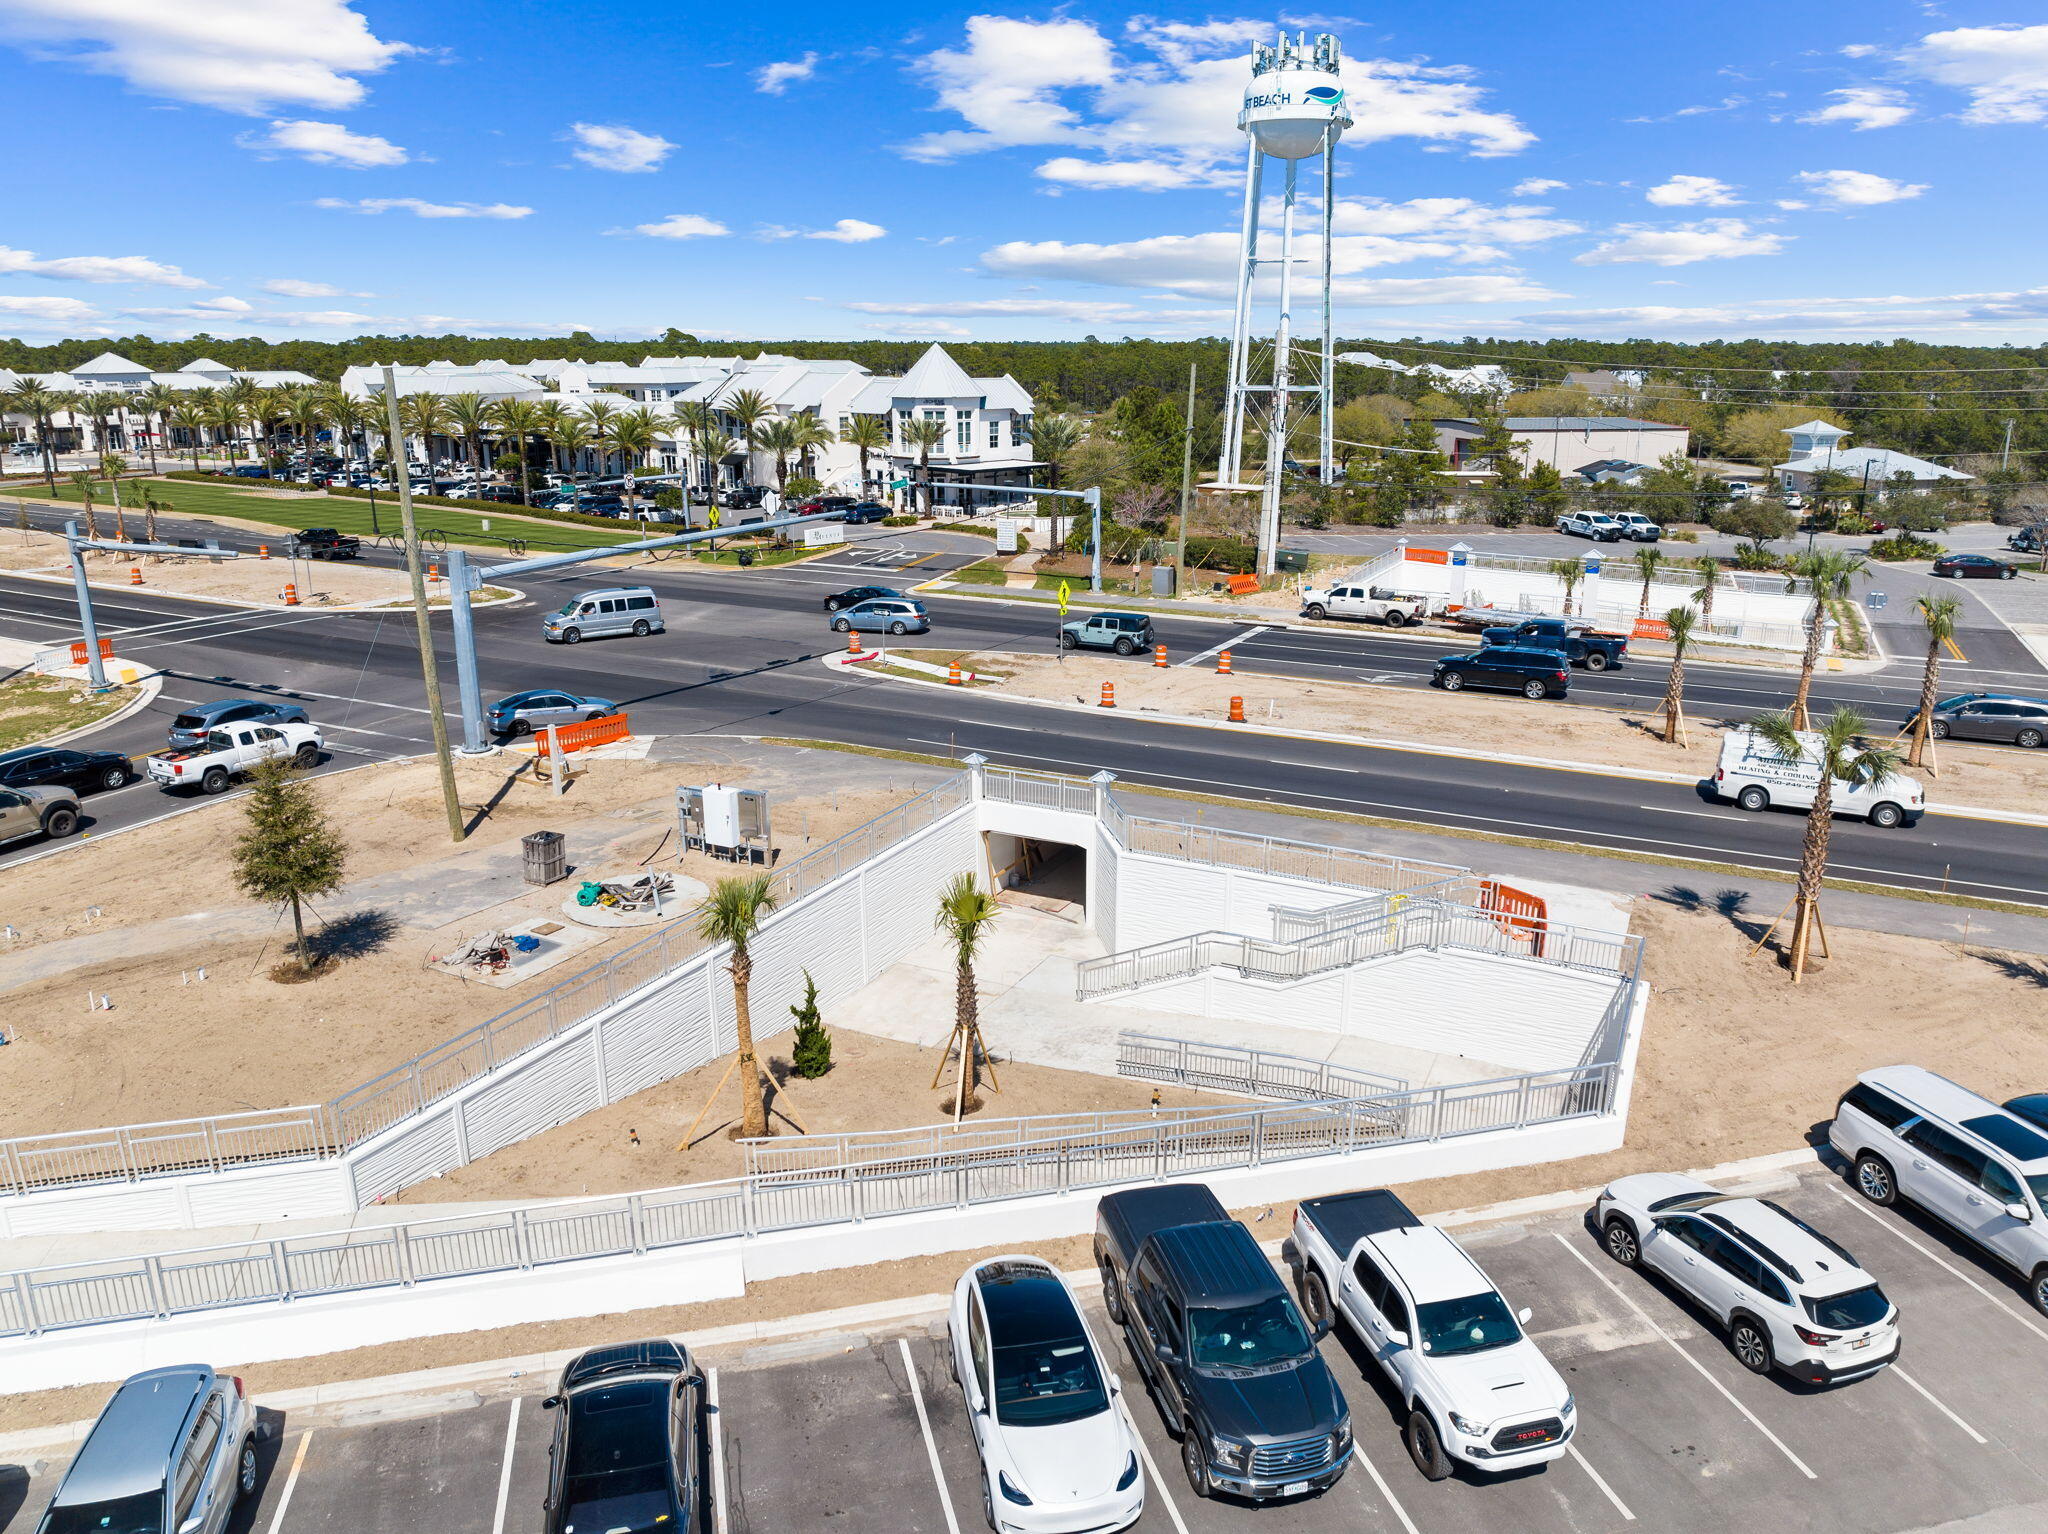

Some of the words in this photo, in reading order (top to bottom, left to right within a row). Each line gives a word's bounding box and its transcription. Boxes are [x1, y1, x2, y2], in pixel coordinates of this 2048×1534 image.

[1253, 93, 1291, 107] BEACH
[1738, 765, 1771, 775] HEATING
[1783, 771, 1816, 781] COOLING
[1518, 1429, 1546, 1441] TOYOTA
